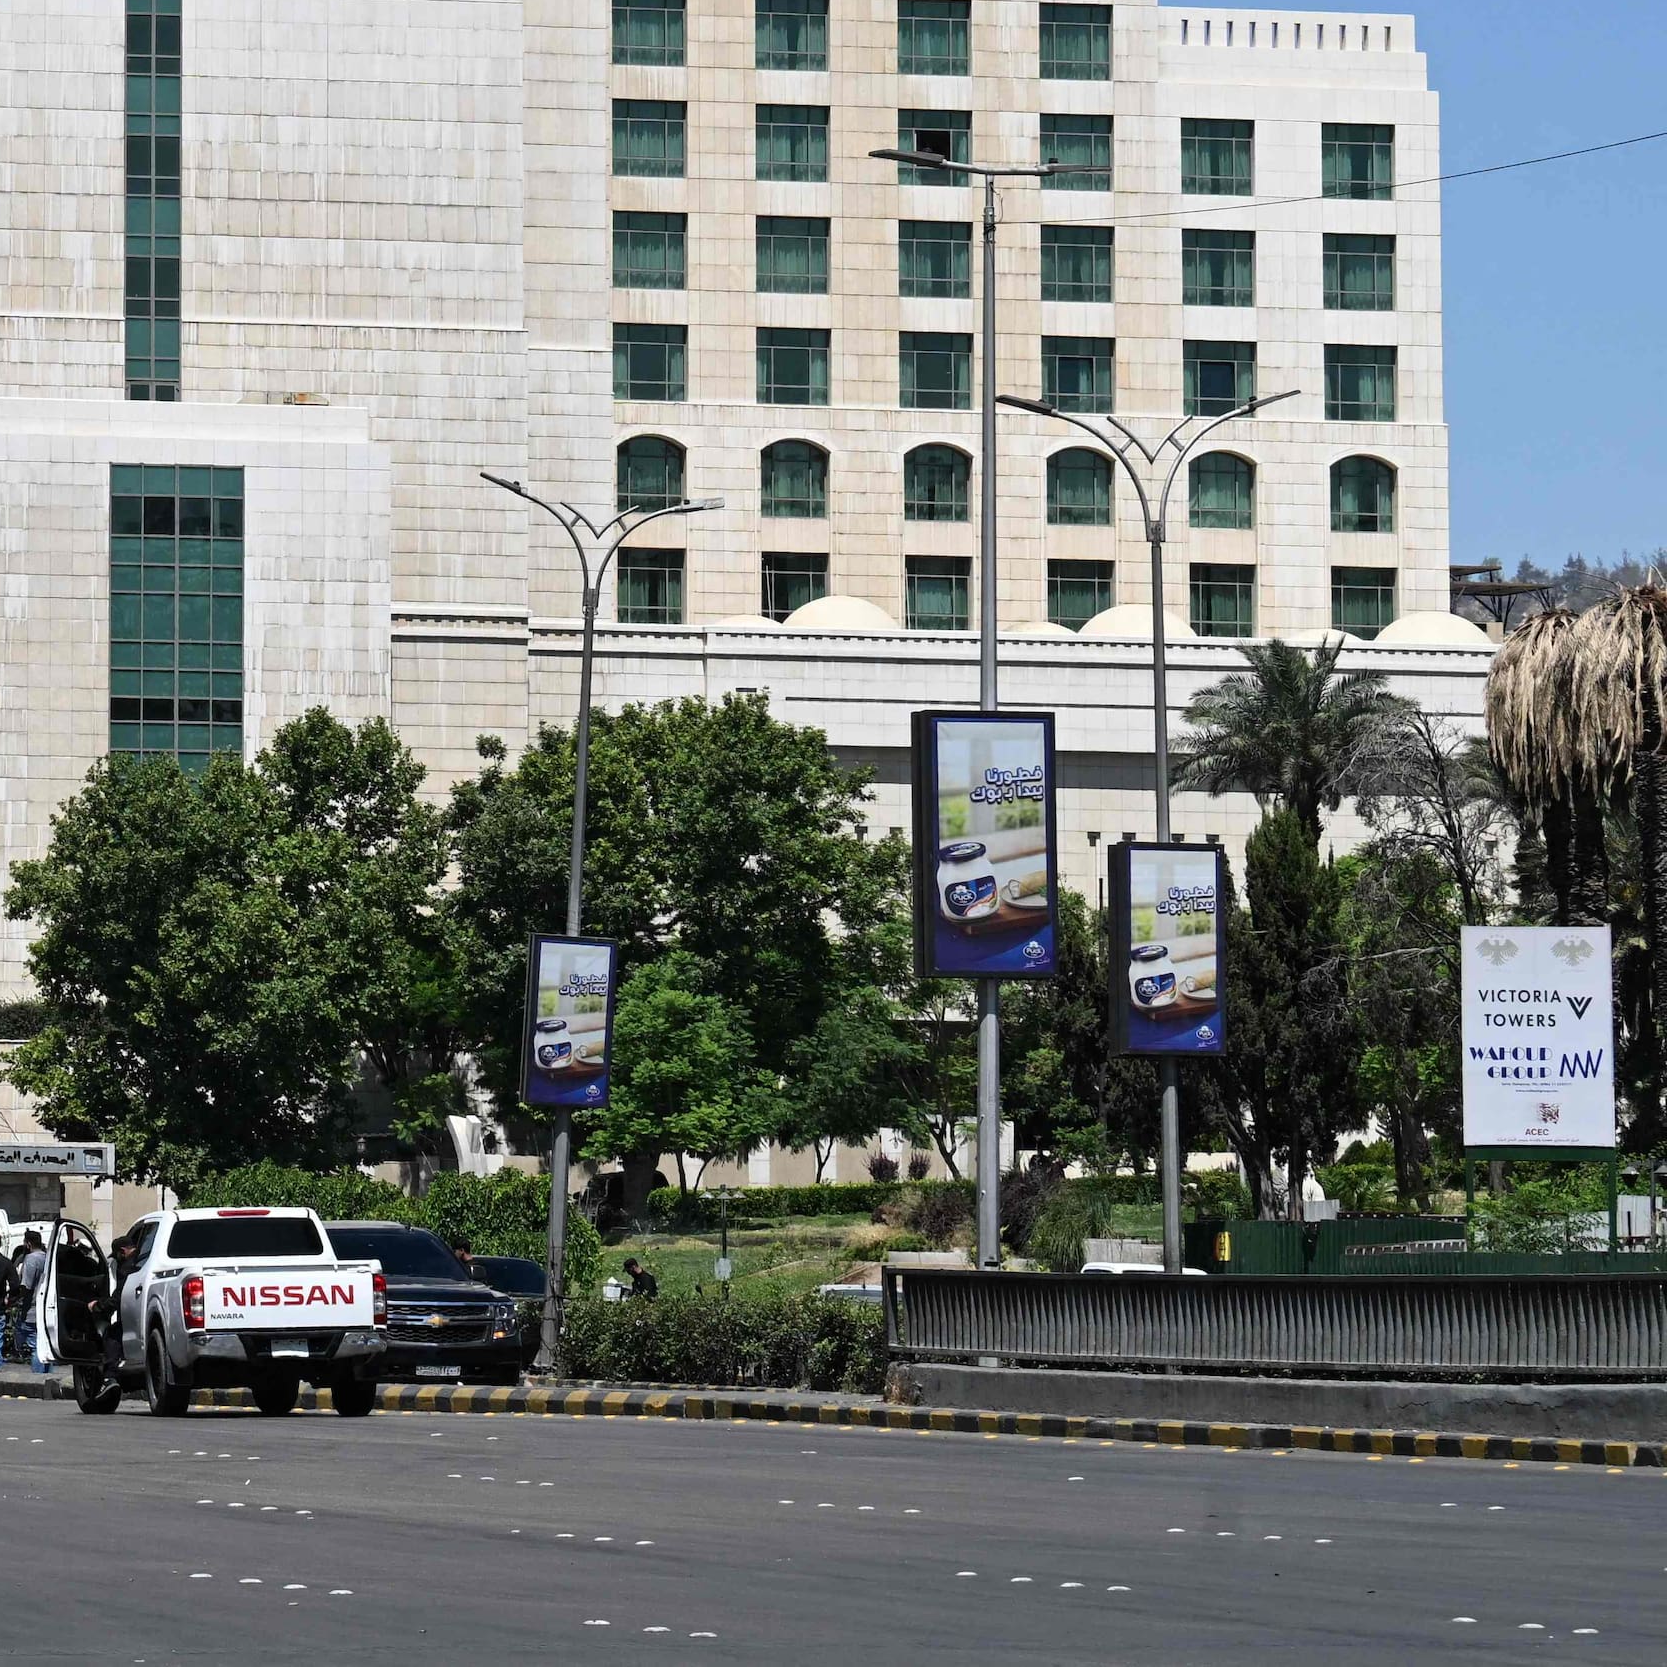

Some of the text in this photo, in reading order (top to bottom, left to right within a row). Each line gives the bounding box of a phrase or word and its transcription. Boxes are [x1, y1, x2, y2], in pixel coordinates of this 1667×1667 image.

[1478, 989, 1562, 1003] VICTORIA
[1484, 1013, 1556, 1027] TOWERS
[1469, 1046, 1553, 1061] WAHOUD
[1487, 1066, 1552, 1080] GROUP
[1525, 1128, 1549, 1136] ACEC
[223, 1285, 355, 1307] NISSAN
